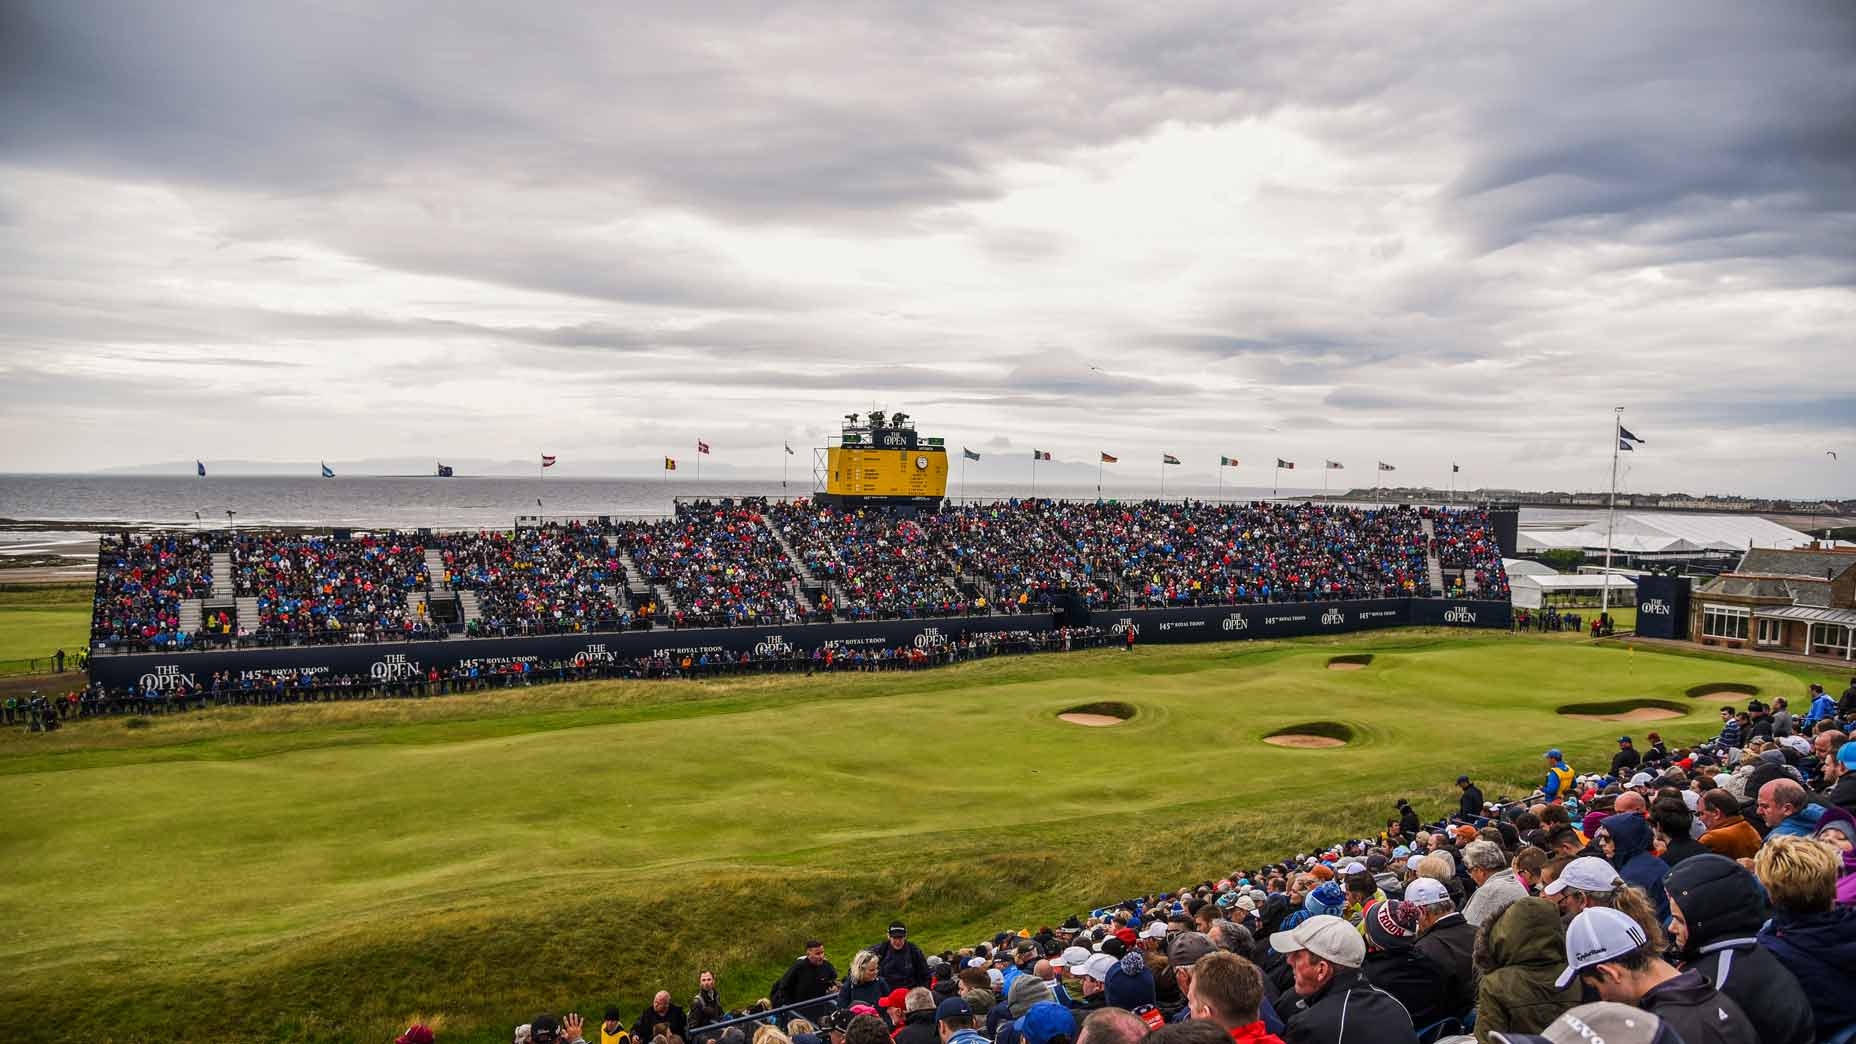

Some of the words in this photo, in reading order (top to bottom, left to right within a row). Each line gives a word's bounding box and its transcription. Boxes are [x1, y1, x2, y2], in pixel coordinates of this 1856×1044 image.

[884, 435, 907, 446] OPEN
[1650, 598, 1663, 606] THE
[1641, 602, 1670, 615] OPEN
[1321, 613, 1344, 625] OPEN
[1444, 610, 1478, 623] OPEN
[1111, 623, 1140, 635] OPN
[1222, 618, 1249, 630] OPEN
[924, 627, 939, 635] THE
[765, 635, 784, 643] THE
[914, 633, 948, 648] OPEN
[585, 643, 606, 653] THE
[384, 654, 407, 663] THE
[511, 655, 538, 663] TROON
[155, 665, 180, 675] THE
[271, 667, 299, 676] ROYAL
[301, 665, 330, 674] TROON
[370, 661, 420, 681] OPEN
[139, 672, 196, 691] OPEN
[1379, 908, 1407, 937] TROON
